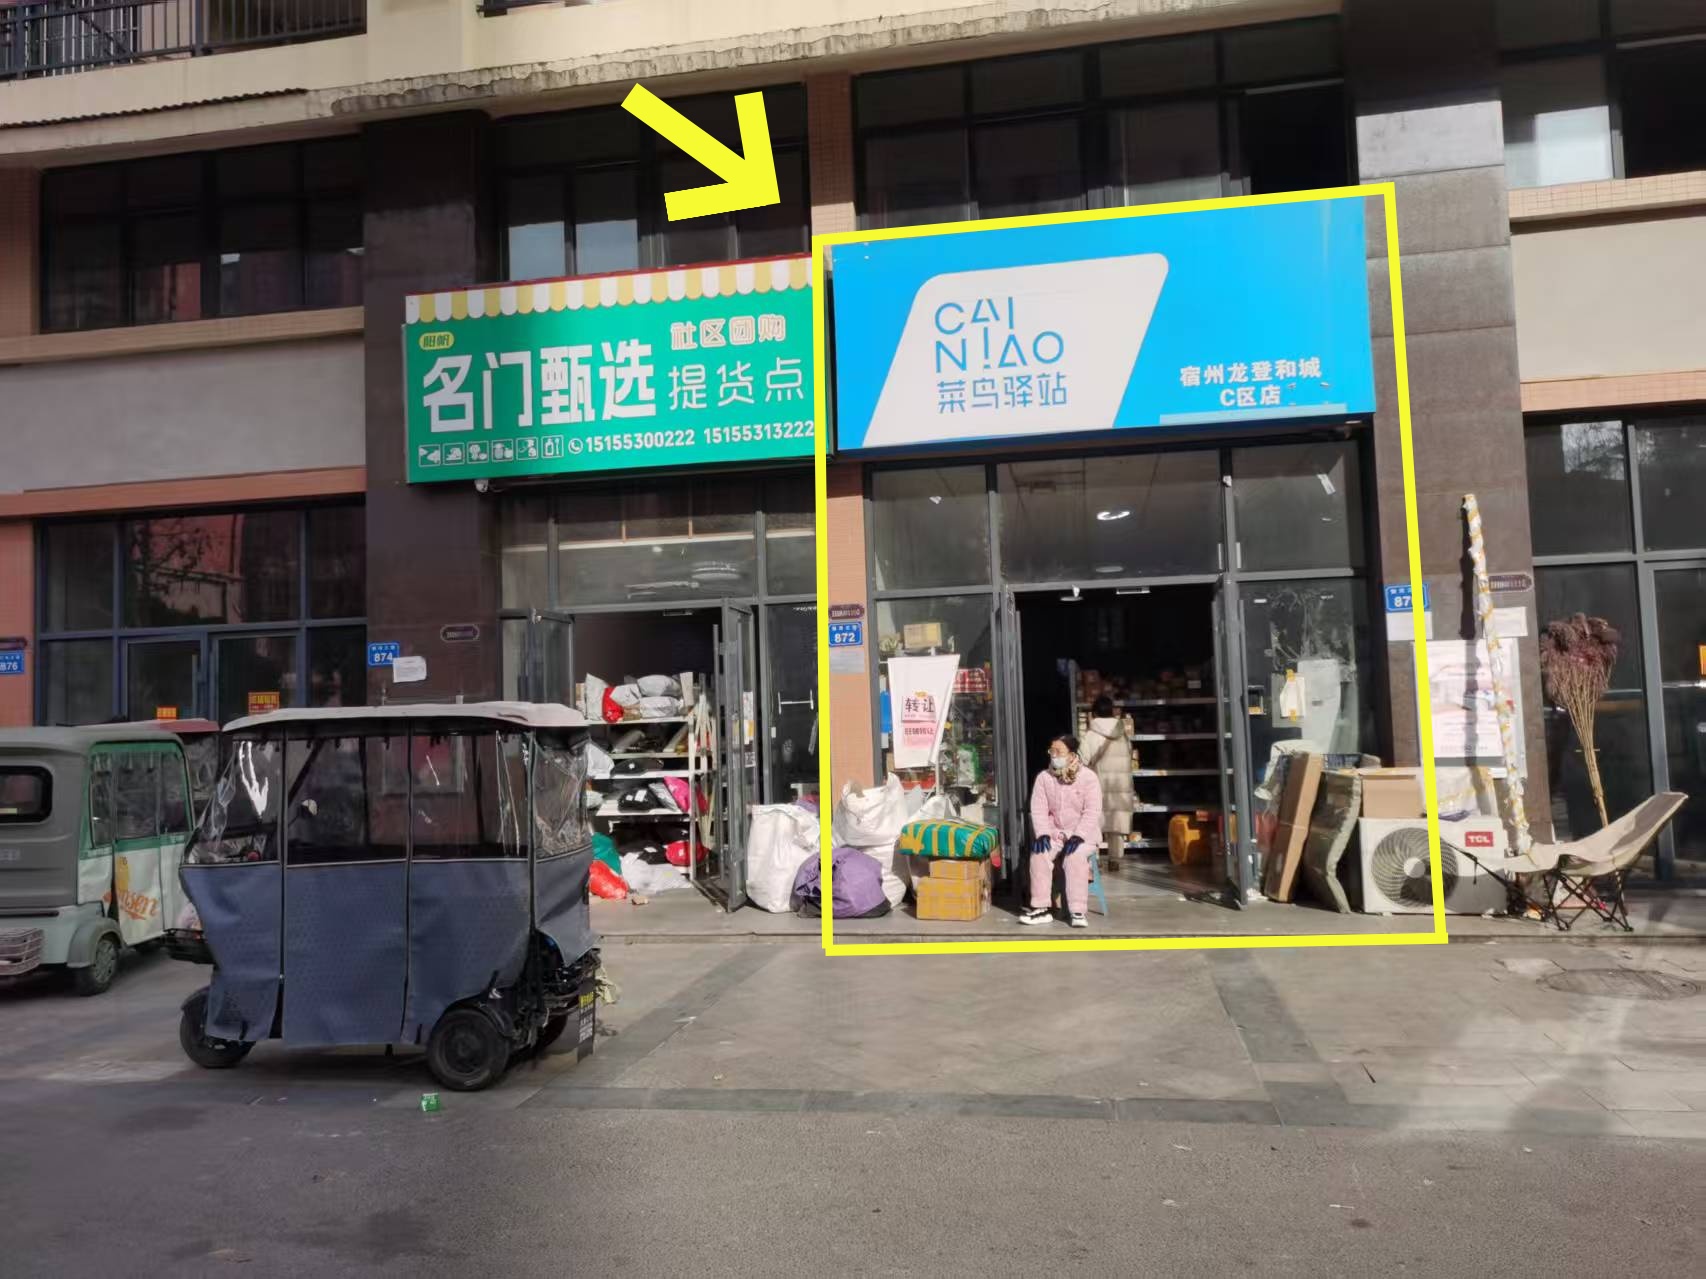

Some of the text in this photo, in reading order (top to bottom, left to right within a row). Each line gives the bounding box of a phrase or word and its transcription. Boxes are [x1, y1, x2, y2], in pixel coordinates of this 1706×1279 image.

[934, 296, 1014, 335] CAI
[670, 313, 786, 351] 社区团购
[423, 338, 657, 433] 名门甄选
[668, 356, 805, 411] 提货点
[1179, 357, 1323, 388] 宿州龙登和城
[936, 371, 1067, 414] 菜鸟驿站
[1219, 384, 1281, 407] C区店
[585, 419, 815, 453] 15155300222 15155313222
[834, 632, 856, 643] 872
[374, 652, 393, 663] 874
[904, 697, 935, 713] 转让
[1467, 835, 1491, 844] TCL
